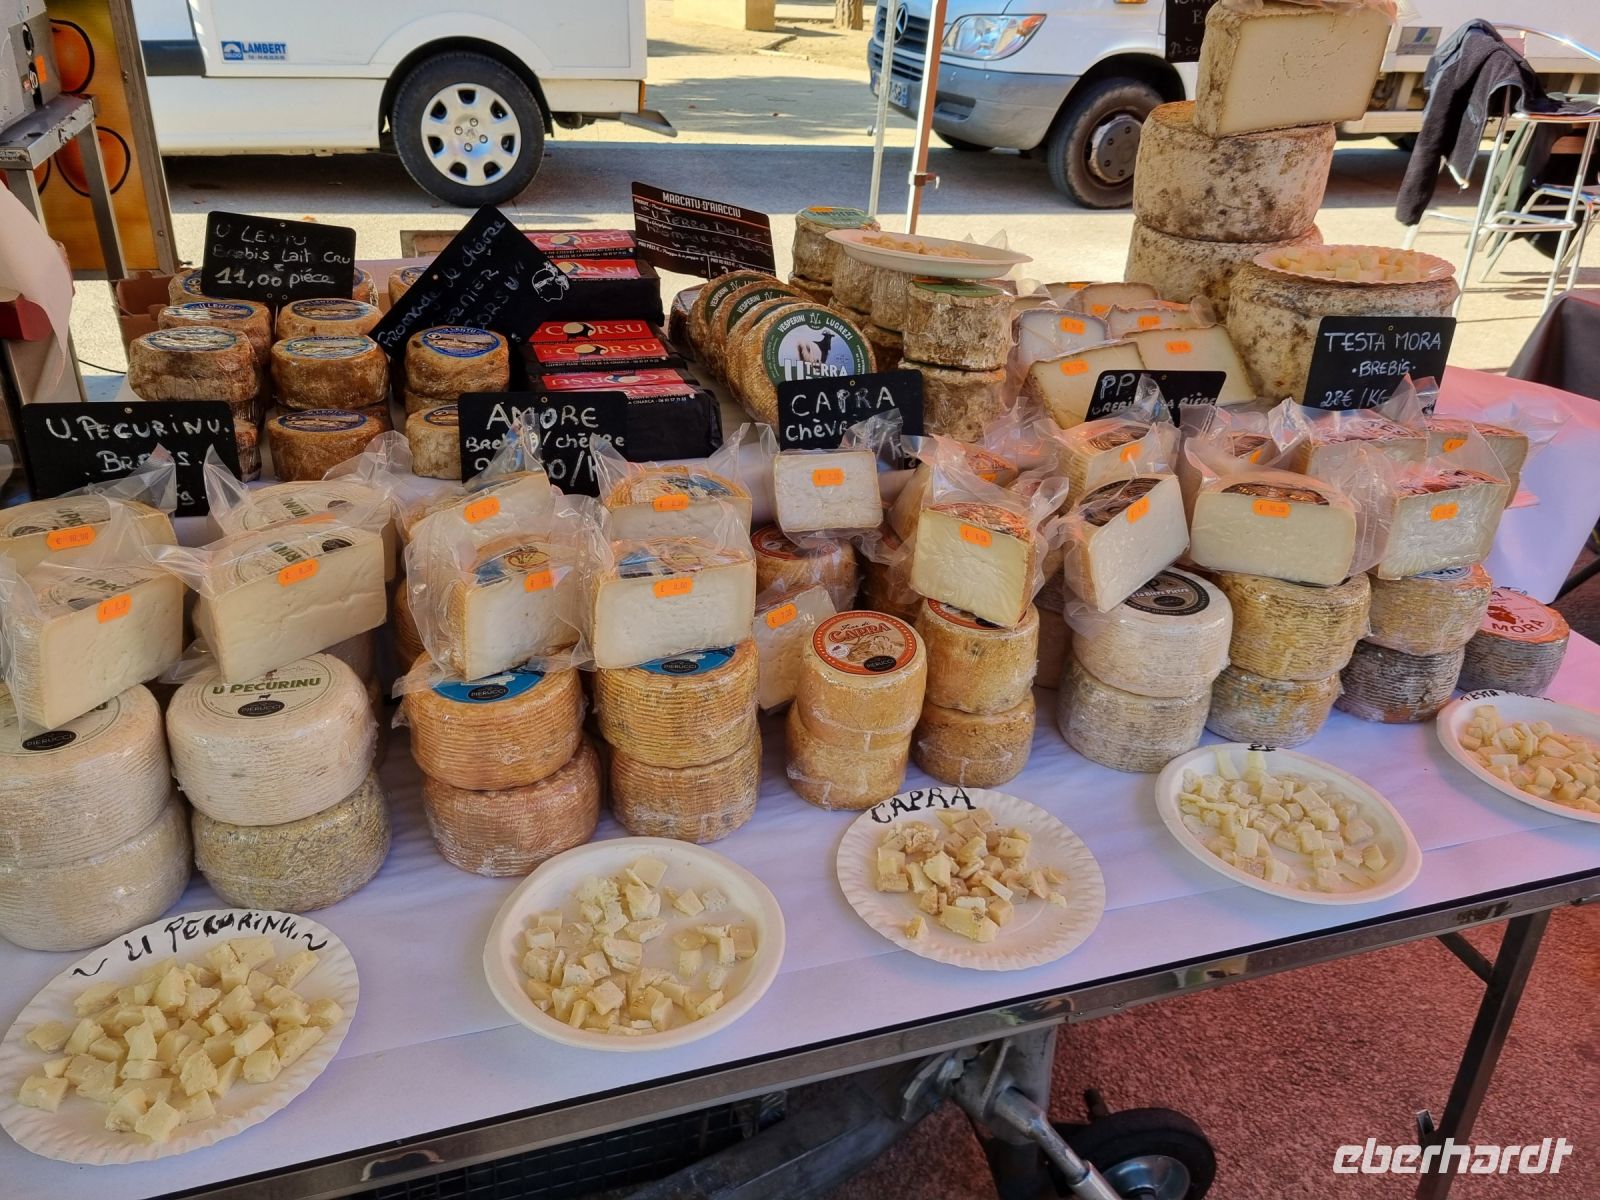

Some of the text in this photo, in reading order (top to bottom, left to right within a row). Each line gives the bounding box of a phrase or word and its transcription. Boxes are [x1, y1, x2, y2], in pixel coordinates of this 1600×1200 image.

[241, 42, 287, 54] LAMBERT
[662, 191, 701, 209] MARCATU
[702, 200, 741, 218] D'AIACCIU
[777, 314, 854, 341] VESPERINI LUGREZI
[1323, 331, 1442, 352] TESTA MORA
[804, 360, 849, 378] TERRA
[791, 386, 896, 417] CAPRA
[828, 621, 892, 644] CAPRA
[1491, 619, 1545, 634] MORA
[212, 677, 321, 695] U PECURINU
[26, 733, 74, 747] PIERUCCI
[870, 783, 977, 824] CAPRA
